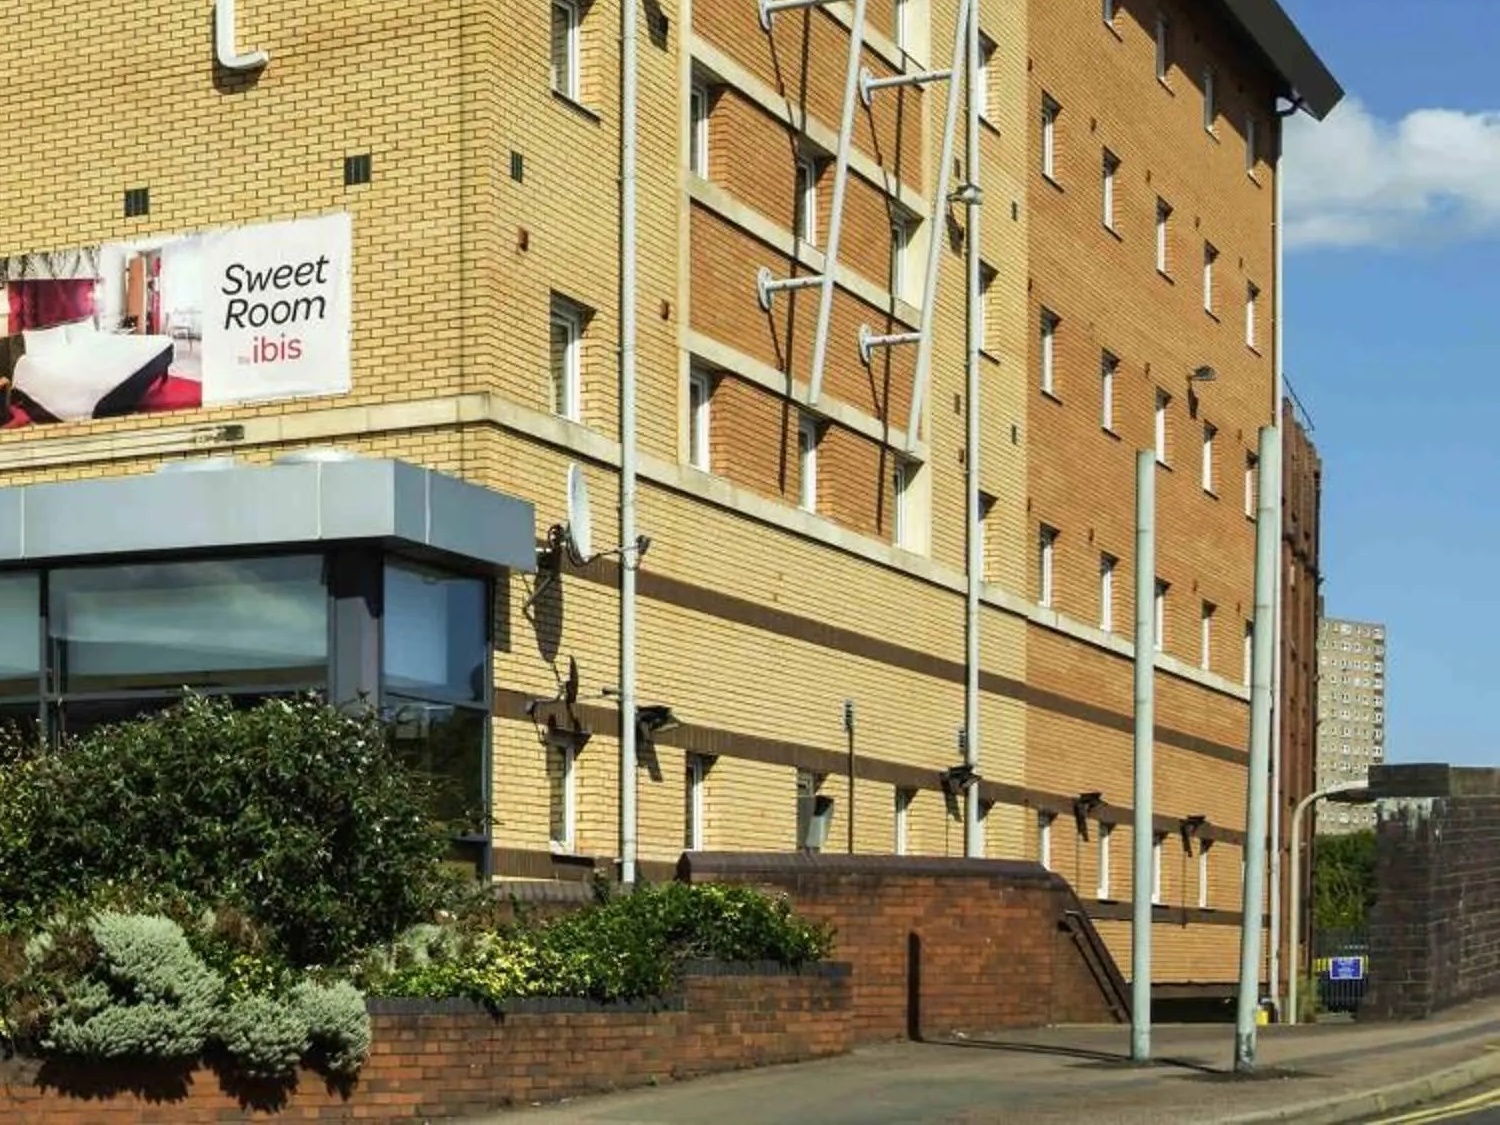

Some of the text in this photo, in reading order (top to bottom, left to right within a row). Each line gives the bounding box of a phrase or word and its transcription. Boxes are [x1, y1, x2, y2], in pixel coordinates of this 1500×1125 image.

[221, 254, 330, 295] Sweet
[224, 295, 327, 330] Room
[252, 332, 303, 364] ibis
